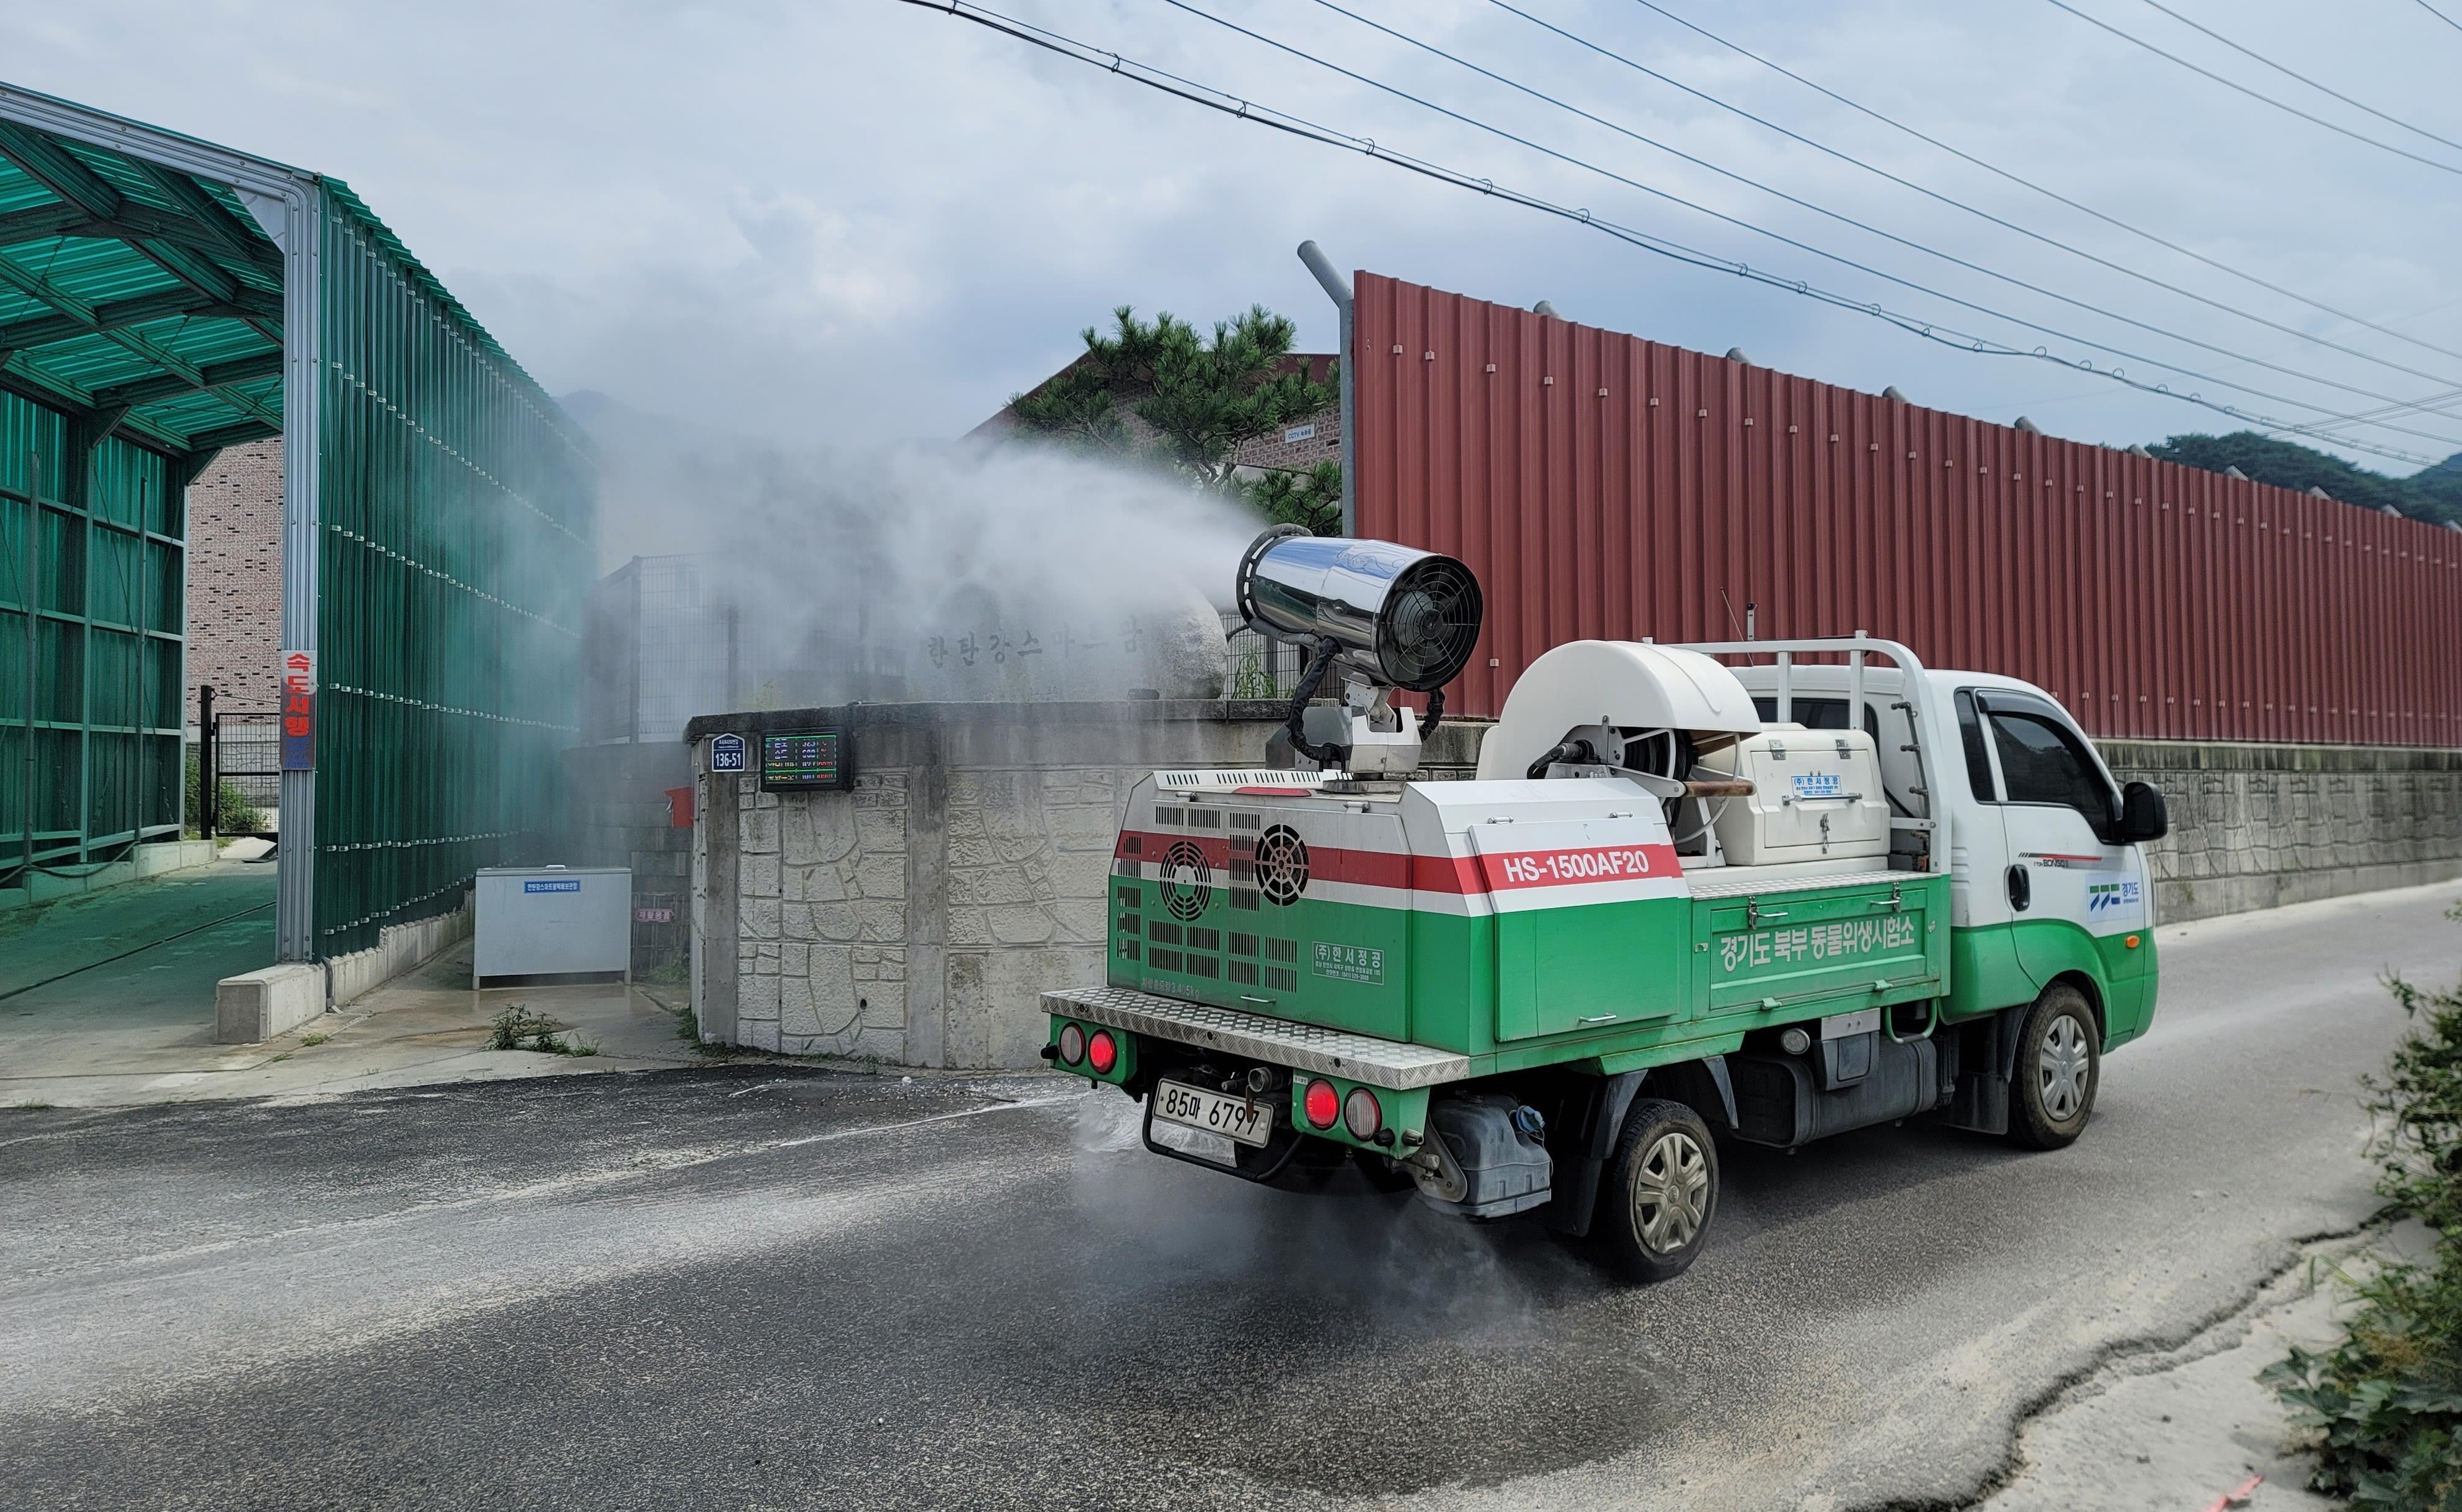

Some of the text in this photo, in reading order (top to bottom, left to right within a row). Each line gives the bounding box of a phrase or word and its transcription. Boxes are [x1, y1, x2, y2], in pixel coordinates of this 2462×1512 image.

[285, 653, 310, 737] 속도서행
[715, 753, 741, 767] 136-51
[1503, 850, 1649, 882] HS-1500AF20
[2122, 882, 2138, 897] 경기도
[1720, 916, 1914, 972] 경기도 북부 동물위생시험소
[1166, 1089, 1260, 1135] 85마 6797
